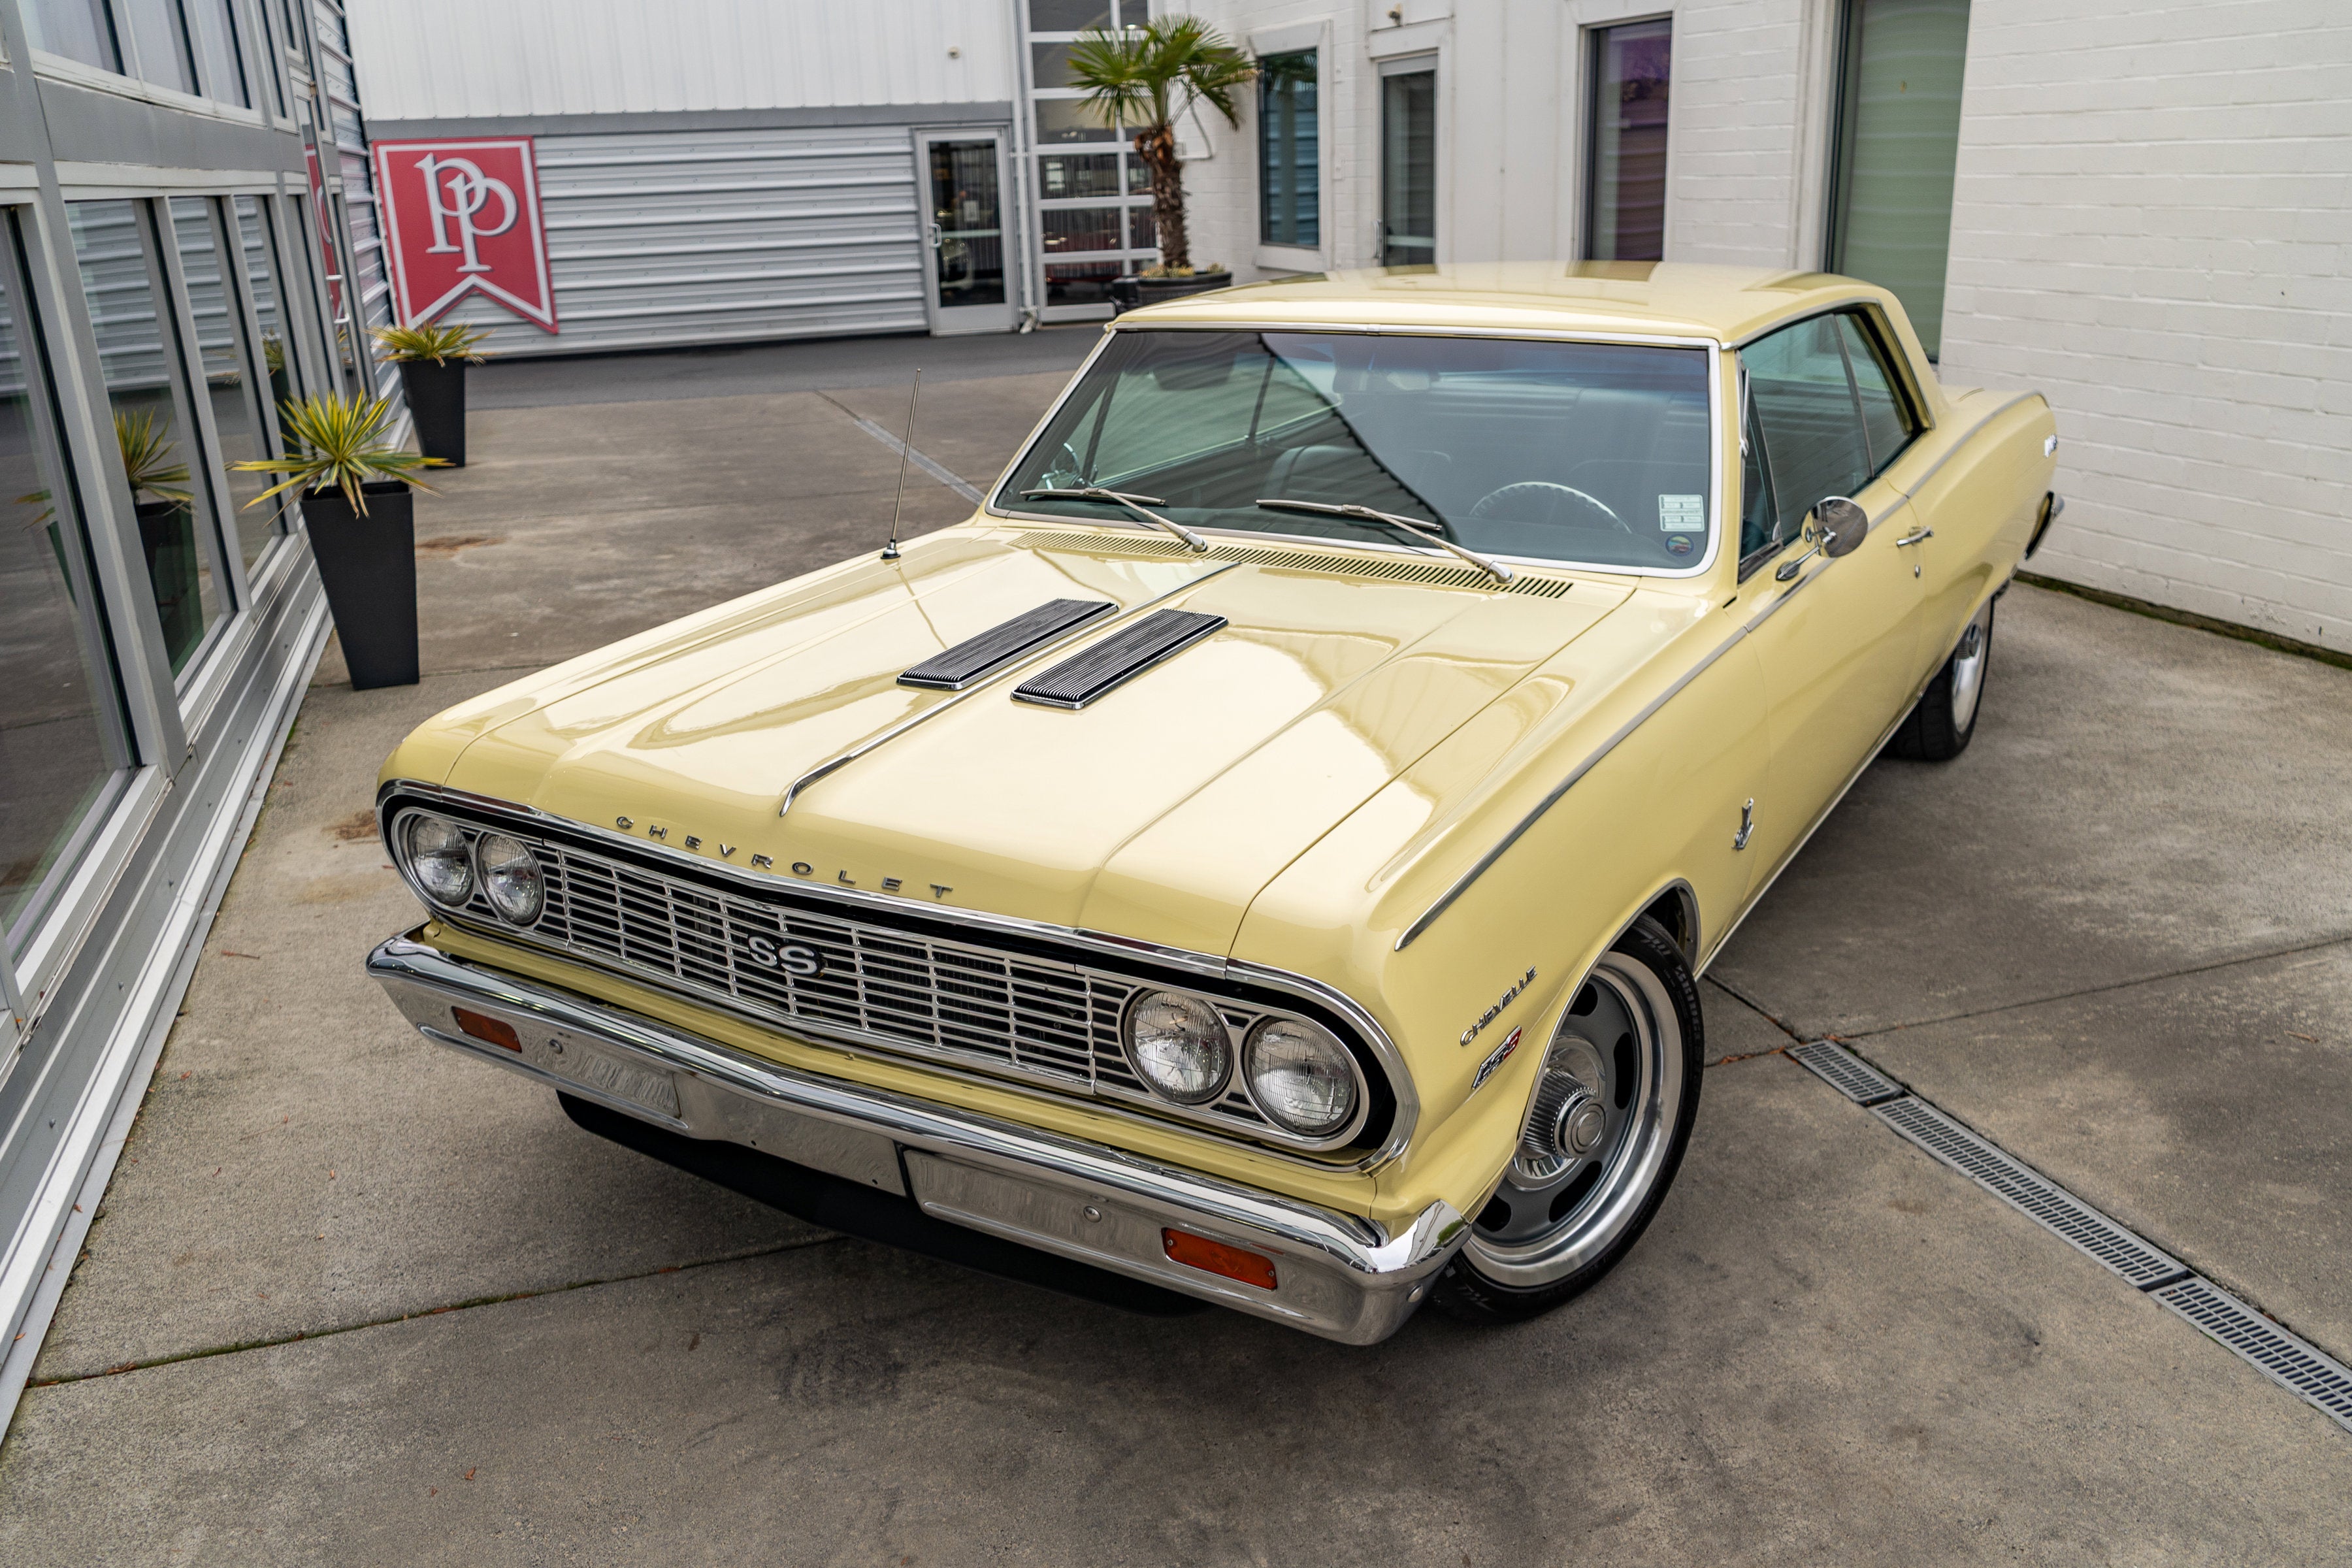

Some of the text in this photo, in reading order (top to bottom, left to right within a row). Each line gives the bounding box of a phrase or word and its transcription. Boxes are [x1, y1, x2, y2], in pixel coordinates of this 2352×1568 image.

[615, 815, 953, 898] CHEVROLET
[748, 936, 818, 975] SS
[1460, 964, 1538, 1047] CHEVELLE
